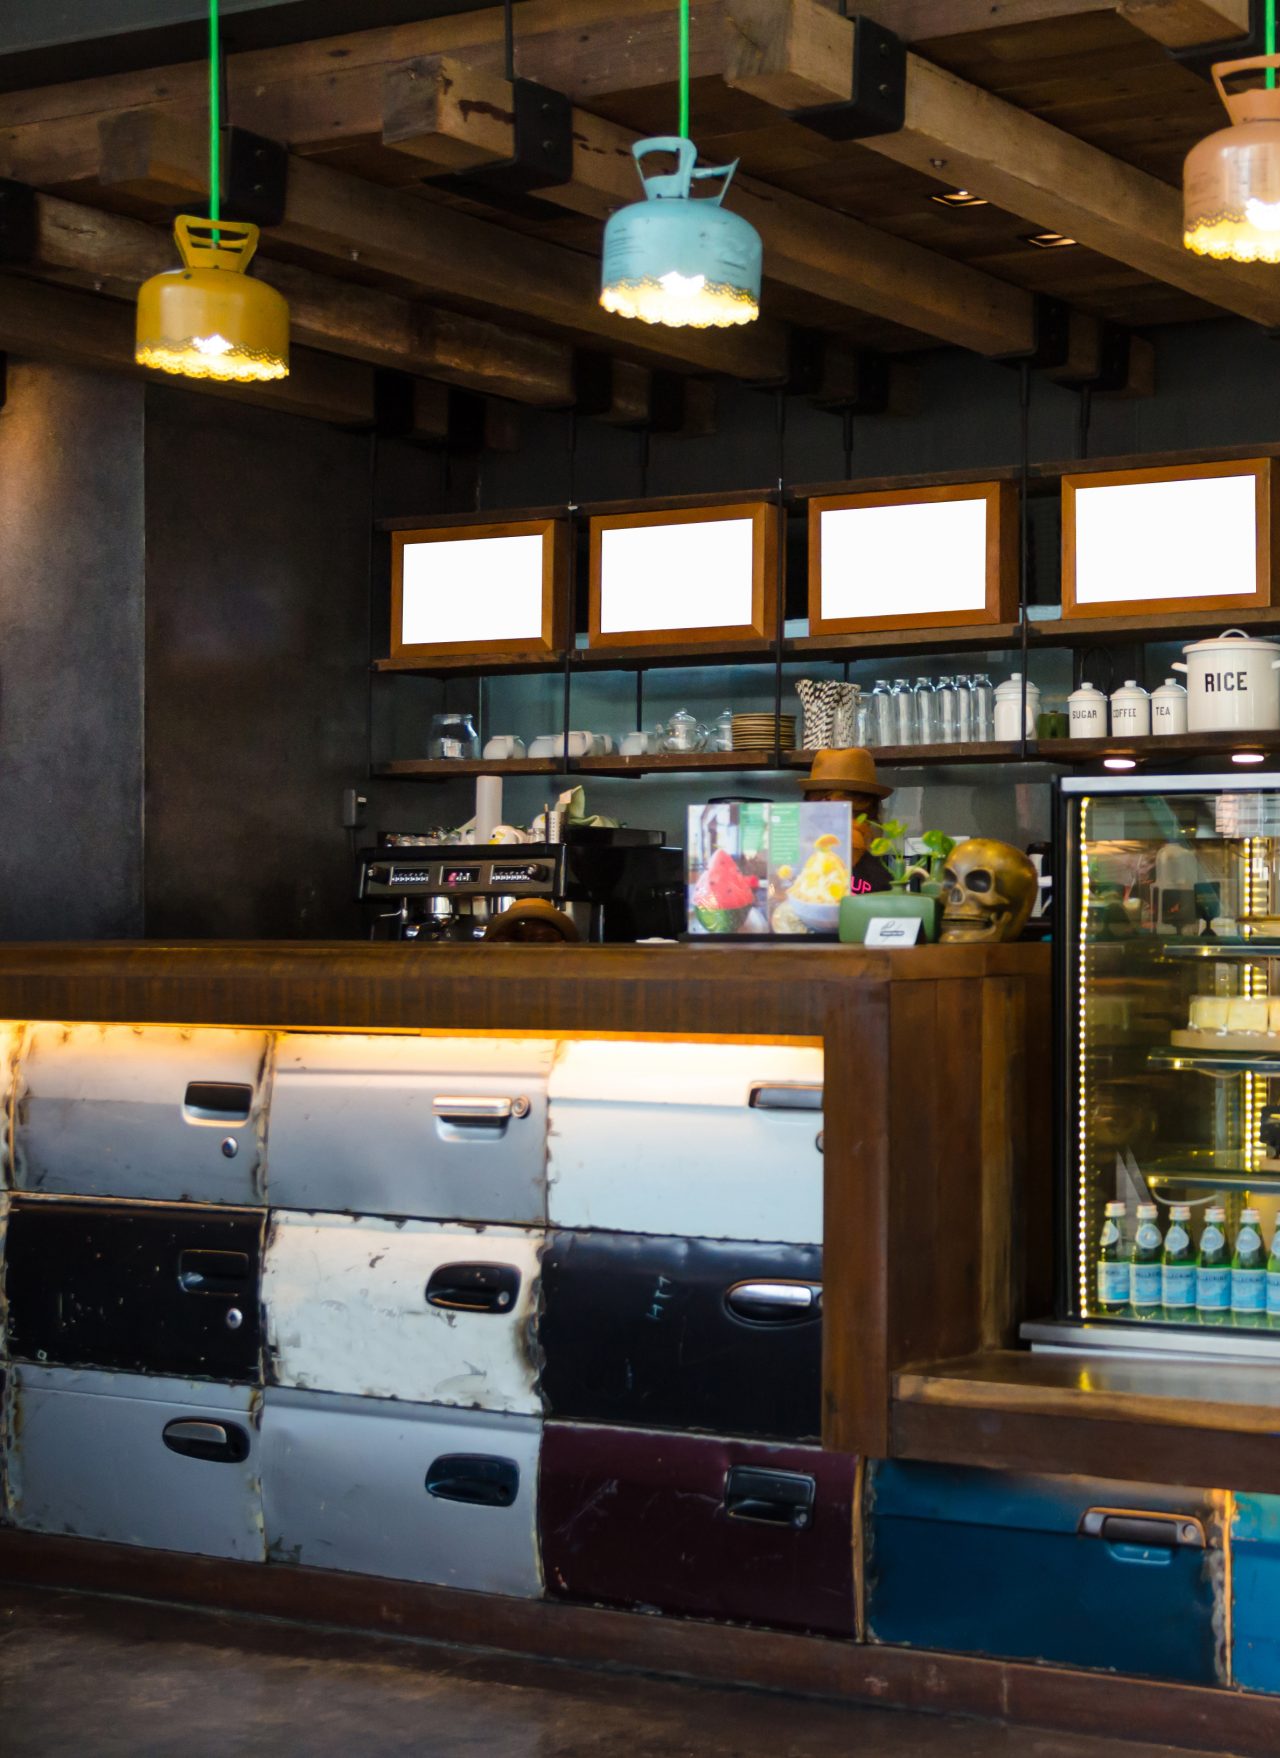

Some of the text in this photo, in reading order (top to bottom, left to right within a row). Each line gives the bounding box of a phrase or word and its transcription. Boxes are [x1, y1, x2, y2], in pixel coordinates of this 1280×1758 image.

[1204, 671, 1248, 693] RICE
[1072, 709, 1097, 720] SUGAR
[1112, 708, 1137, 718] COFFEE
[1155, 706, 1171, 716] TEA
